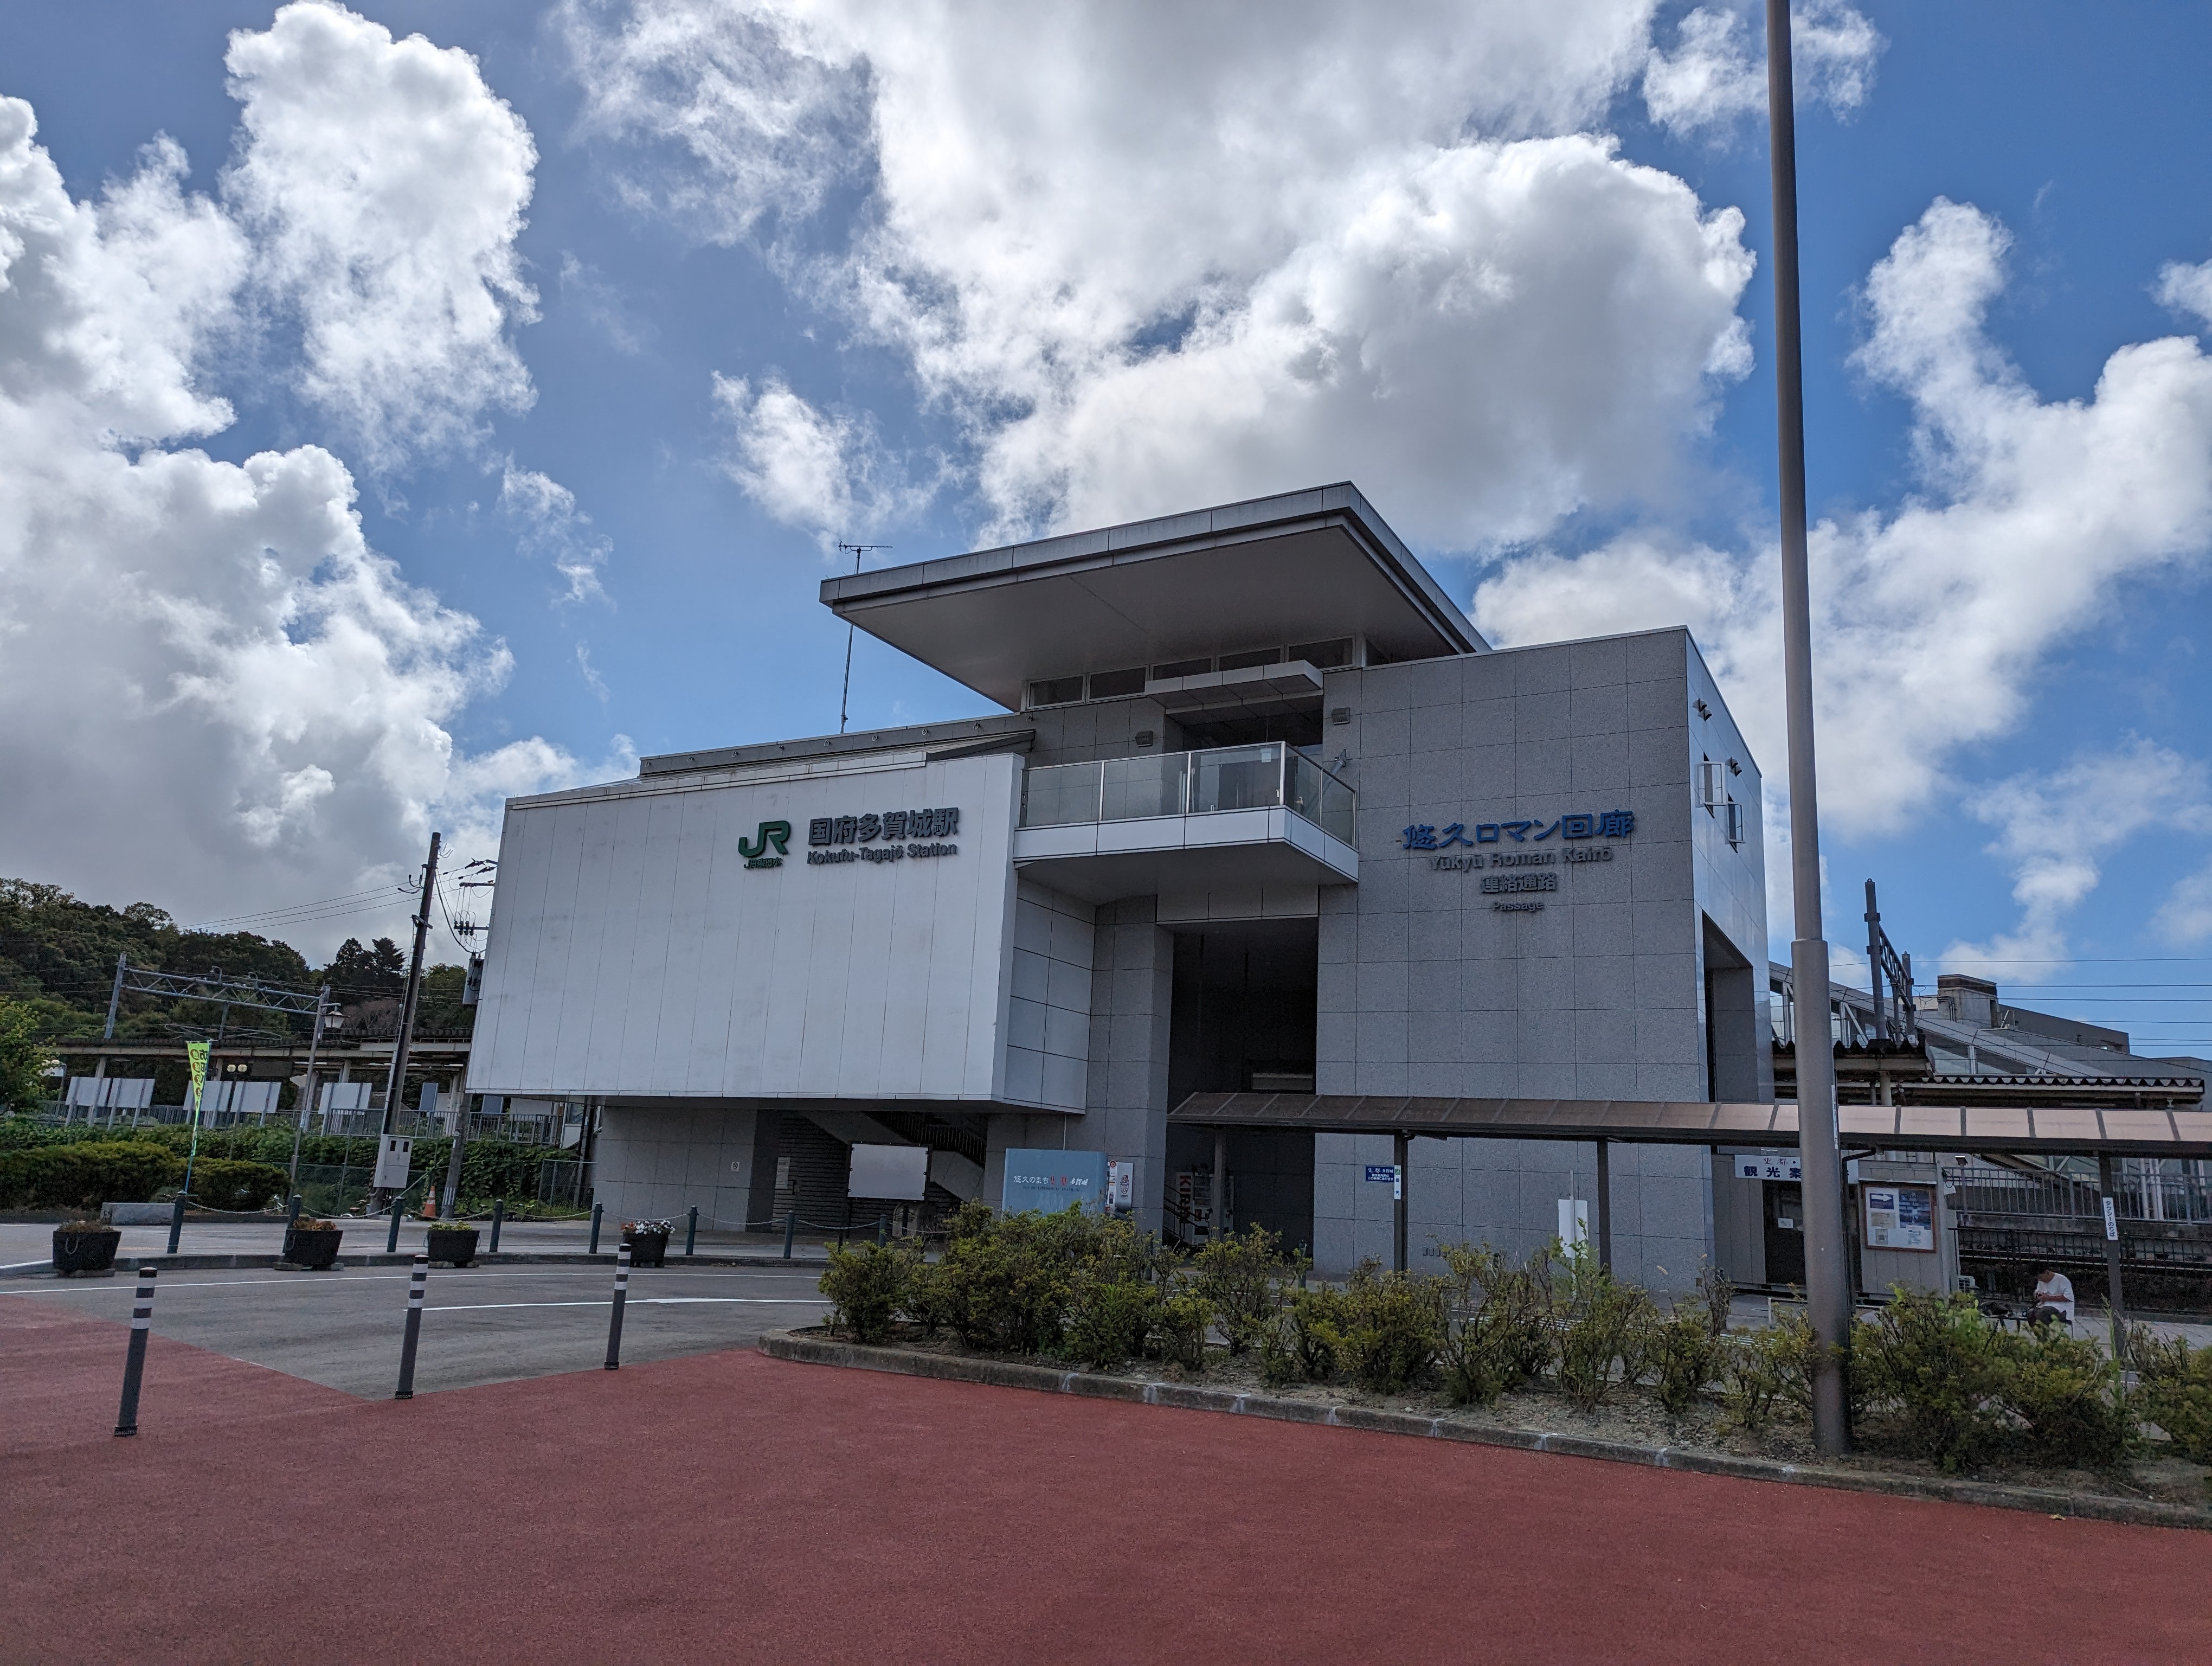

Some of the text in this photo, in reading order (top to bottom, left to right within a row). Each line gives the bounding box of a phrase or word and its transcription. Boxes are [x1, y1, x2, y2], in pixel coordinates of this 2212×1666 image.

[808, 807, 959, 846] 国府多賀城駅
[1403, 809, 1635, 850] 悠久ロマン回廊
[738, 820, 791, 858] JR
[743, 857, 783, 869] JR東日本
[807, 842, 957, 864] Kokufu-Tagajō Station
[1490, 851, 1555, 867] Roman
[1561, 846, 1615, 863] Kairō
[1481, 872, 1557, 894] 連絡通路
[1492, 900, 1544, 912] Passage
